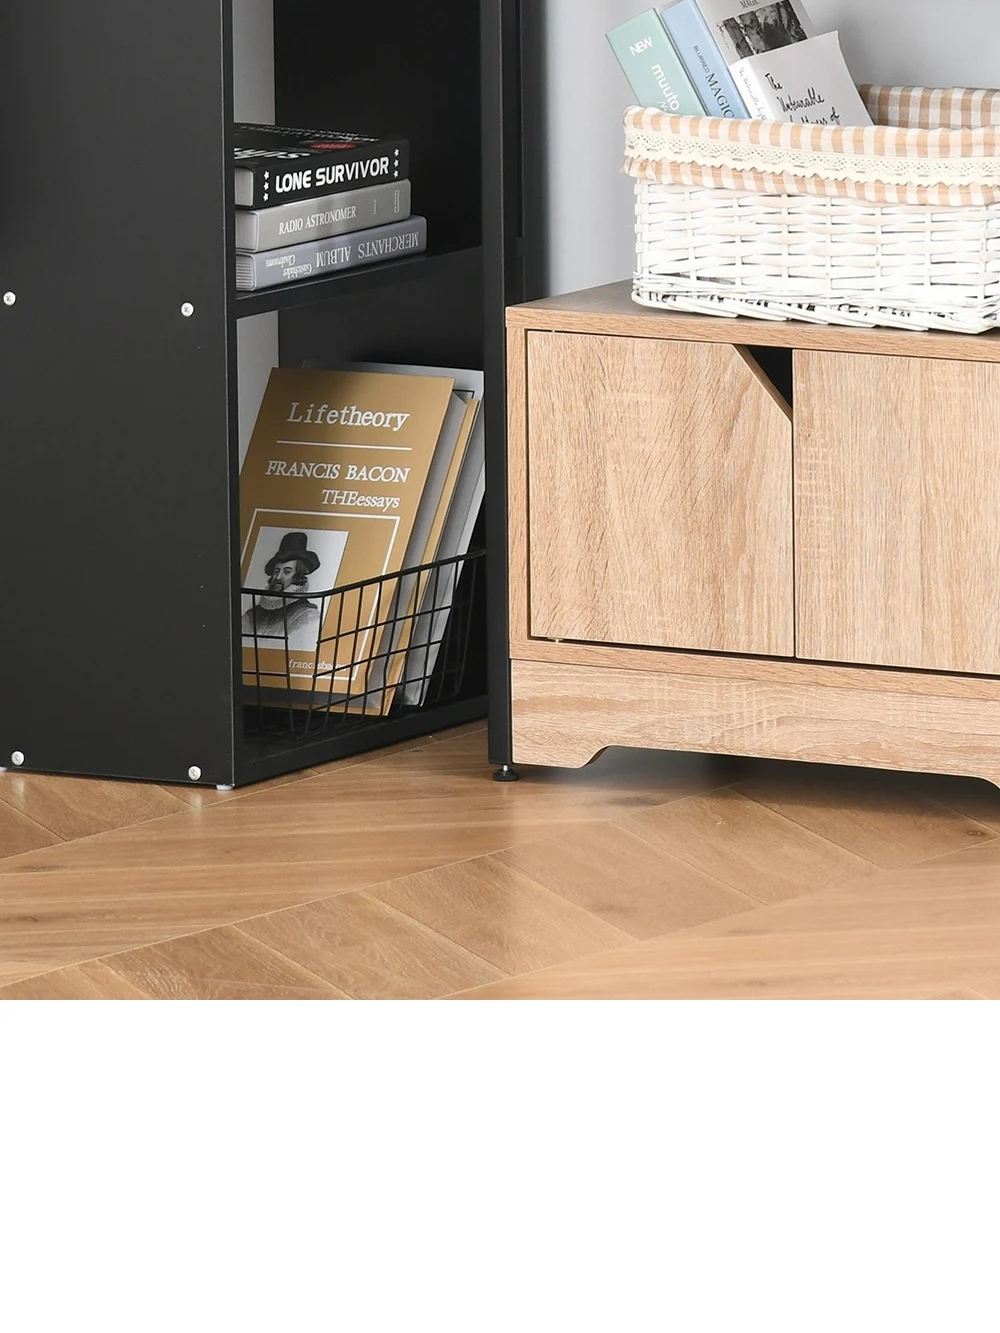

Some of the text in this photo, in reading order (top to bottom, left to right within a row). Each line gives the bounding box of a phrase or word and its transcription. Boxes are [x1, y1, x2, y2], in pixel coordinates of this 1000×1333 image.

[629, 36, 653, 56] NEW
[651, 64, 680, 111] muuto
[705, 73, 735, 118] MAGIC
[764, 72, 783, 91] The
[776, 87, 825, 113] Unbearable
[275, 156, 390, 194] LONE SURVIVOR
[278, 218, 304, 235] RADIO
[305, 205, 357, 229] ASTRONOMER
[316, 231, 419, 268] MERCHANTS ALBUM
[287, 402, 410, 431] Lifetheory
[266, 460, 410, 484] FRANCIS BACON
[321, 489, 400, 512] THEessays
